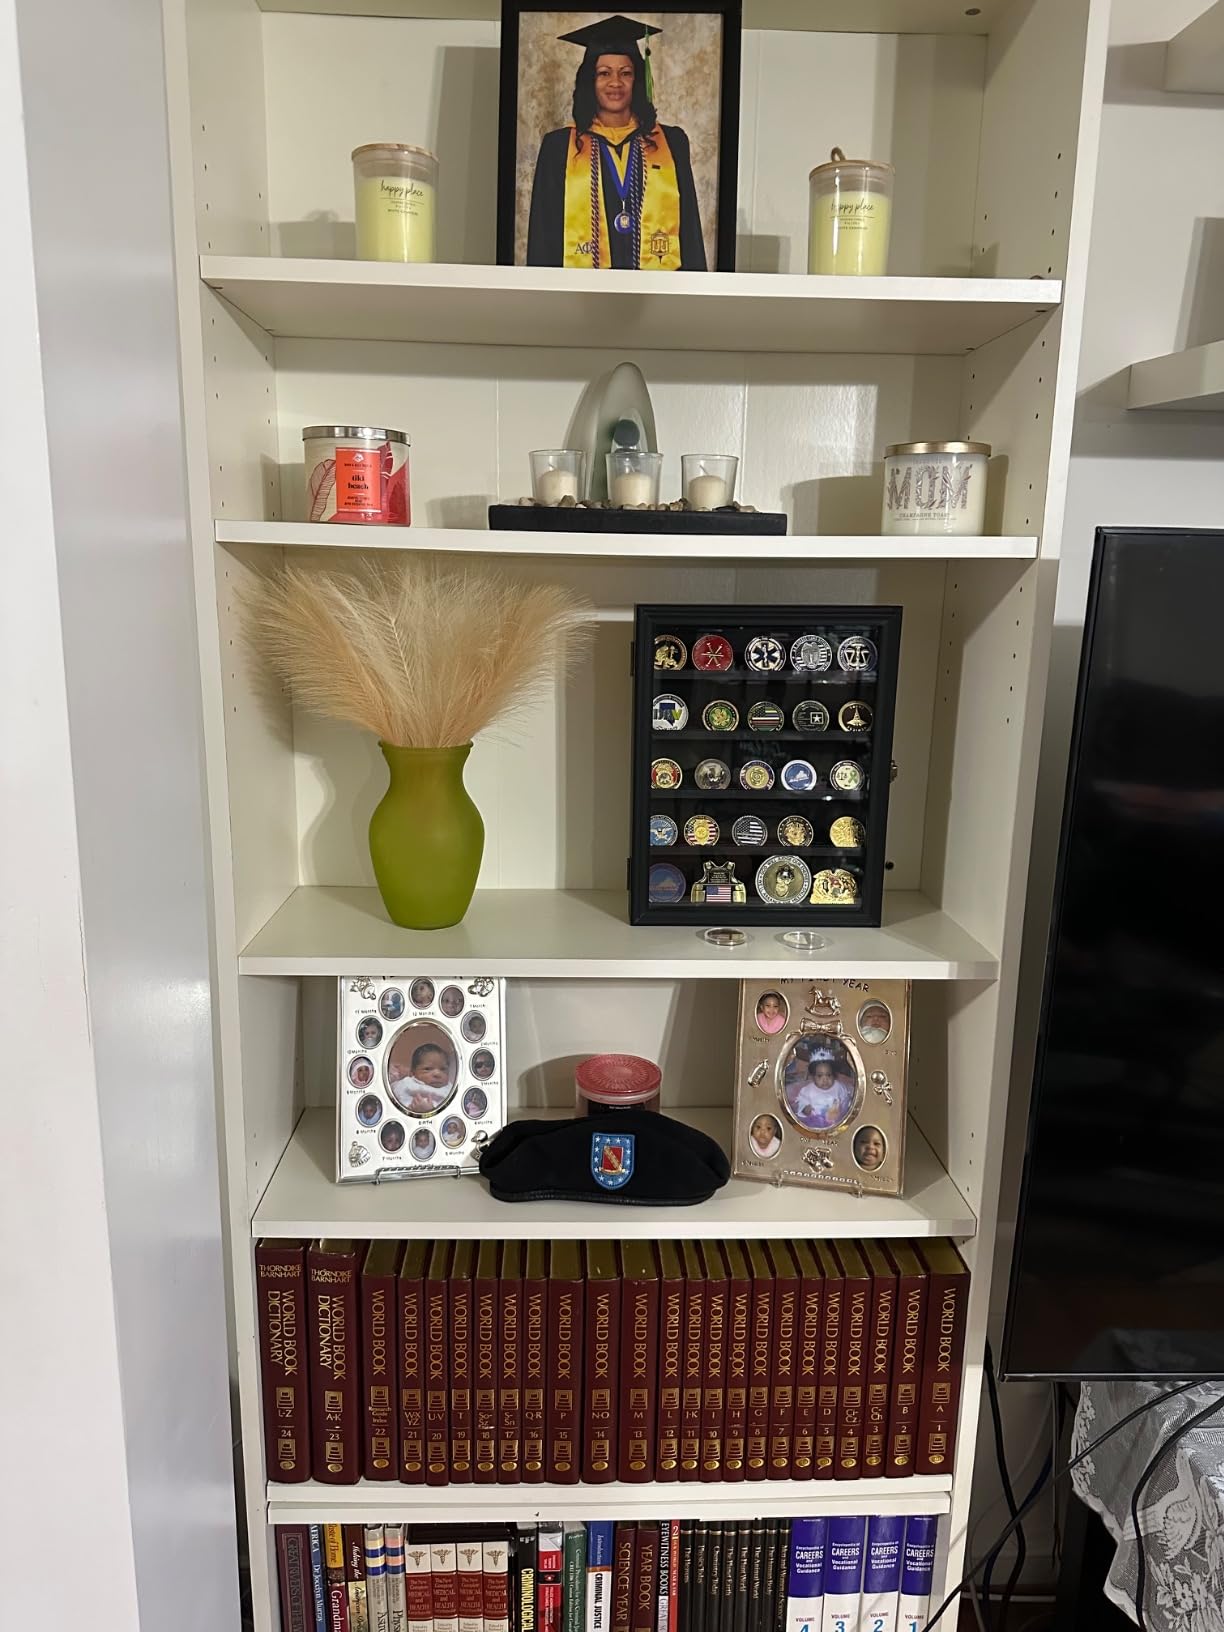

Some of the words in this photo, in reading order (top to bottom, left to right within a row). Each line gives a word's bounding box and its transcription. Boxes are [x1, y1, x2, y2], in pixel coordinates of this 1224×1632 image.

[380, 180, 404, 198] happy
[404, 183, 424, 199] place
[887, 465, 972, 511] MOM
[259, 1264, 301, 1272] THORNDIKE
[311, 1268, 352, 1276] THORNDIKE
[268, 1290, 283, 1365] DICTIONARY
[282, 1289, 296, 1337] WORLD
[332, 1295, 345, 1342] WORLD
[372, 1290, 385, 1337] WORLD
[404, 1293, 418, 1340] WORLD
[430, 1294, 443, 1342] WORLD
[454, 1293, 468, 1340] WORLD
[480, 1294, 492, 1341] WORLD
[504, 1293, 517, 1341] WORLD
[528, 1293, 542, 1340] WORLD
[558, 1293, 572, 1341] WORLD
[596, 1293, 610, 1340] WORLD
[634, 1293, 648, 1340] WORLD
[666, 1292, 680, 1340] WORLD
[688, 1293, 702, 1340] WORLD
[710, 1294, 724, 1341] WORLD
[734, 1293, 748, 1340] WORLD
[756, 1292, 770, 1338] WORLD
[780, 1292, 794, 1338] WORLD
[804, 1292, 819, 1338] WORLD
[826, 1292, 840, 1338] WORLD
[850, 1292, 865, 1338] WORLD
[876, 1290, 892, 1336] WORLD
[906, 1289, 920, 1336] WORLD
[940, 1288, 956, 1334] WORLD
[318, 1295, 332, 1369] DICTIONARY
[284, 1340, 298, 1376] BOOK
[333, 1345, 346, 1380] BOOK
[372, 1340, 386, 1376] BOOK
[405, 1343, 418, 1379] BOOK
[430, 1344, 443, 1380] BOOK
[454, 1343, 468, 1379] BOOK
[480, 1344, 492, 1379] BOOK
[504, 1344, 517, 1379] BOOK
[528, 1344, 541, 1379] BOOK
[558, 1344, 571, 1380] BOOK
[595, 1344, 609, 1379] BOOK
[634, 1343, 647, 1378] BOOK
[665, 1342, 678, 1378] BOOK
[687, 1343, 700, 1378] BOOK
[708, 1344, 722, 1378] BOOK
[732, 1343, 746, 1378] BOOK
[754, 1342, 768, 1376] BOOK
[778, 1341, 792, 1376] BOOK
[802, 1341, 816, 1376] BOOK
[824, 1341, 838, 1376] BOOK
[848, 1341, 862, 1376] BOOK
[874, 1340, 888, 1374] BOOK
[902, 1338, 917, 1374] BOOK
[938, 1337, 952, 1372] BOOK
[281, 1430, 292, 1438] 24
[709, 1430, 718, 1438] 10
[640, 1544, 652, 1572] YEAR
[660, 1523, 670, 1568] EYEWITNESS
[796, 1551, 823, 1560] CAREERS
[832, 1548, 860, 1556] CAREERS
[871, 1546, 898, 1556] CAREERS
[906, 1548, 934, 1558] CAREERS
[313, 1564, 320, 1573] Dr
[618, 1542, 632, 1590] SCIENCE
[660, 1570, 669, 1595] BOOKS
[594, 1573, 603, 1603] CRIMINAL
[639, 1576, 652, 1610] BOOK
[316, 1599, 325, 1622] Murray
[593, 1606, 602, 1629] JUSTICE
[616, 1593, 629, 1621] YEAR
